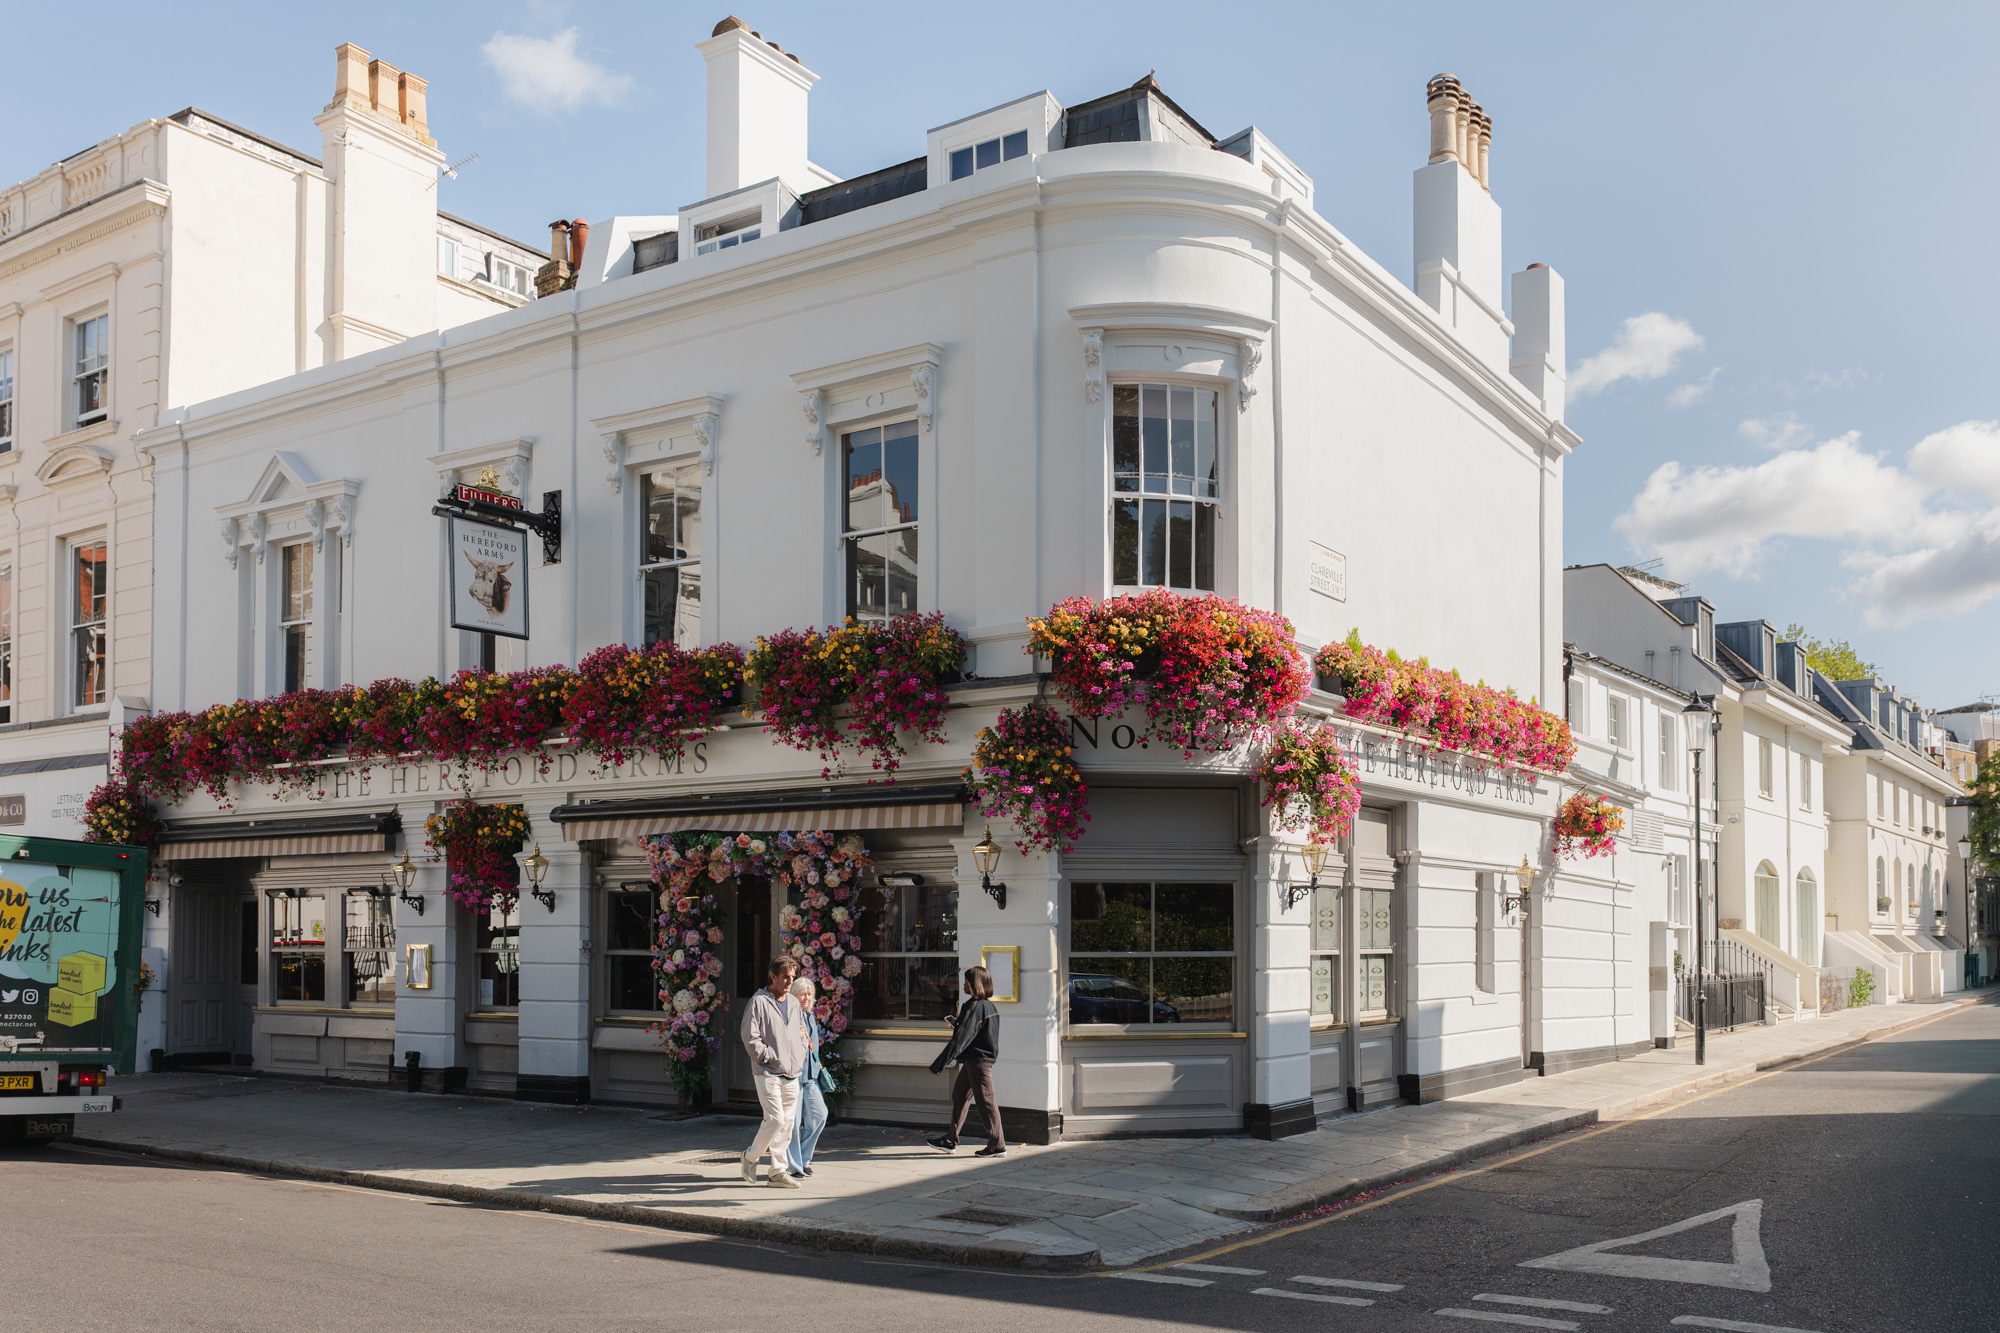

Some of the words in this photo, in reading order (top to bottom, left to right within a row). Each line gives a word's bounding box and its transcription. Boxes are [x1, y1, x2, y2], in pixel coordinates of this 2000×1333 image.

[481, 529, 498, 539] THE
[463, 534, 517, 553] HEREFORD
[477, 547, 504, 560] ARMS
[1311, 562, 1343, 584] CLAREVILLE
[1310, 575, 1330, 592] STREET
[1066, 714, 1148, 750] No.
[314, 770, 371, 799] THE
[389, 753, 577, 794] HEREFORD
[1387, 747, 1487, 795] HEREFORD
[1494, 771, 1535, 806] ARMS
[57, 793, 84, 805] LETTINGS
[51, 808, 61, 818] 020
[62, 807, 75, 817] 7835
[39, 887, 70, 907] us
[21, 906, 87, 934] latest
[60, 968, 81, 978] handled
[50, 1000, 71, 1010] handled
[8, 1078, 28, 1087] PXR
[84, 1103, 107, 1112] Bevan
[27, 1120, 67, 1135] Bevan
